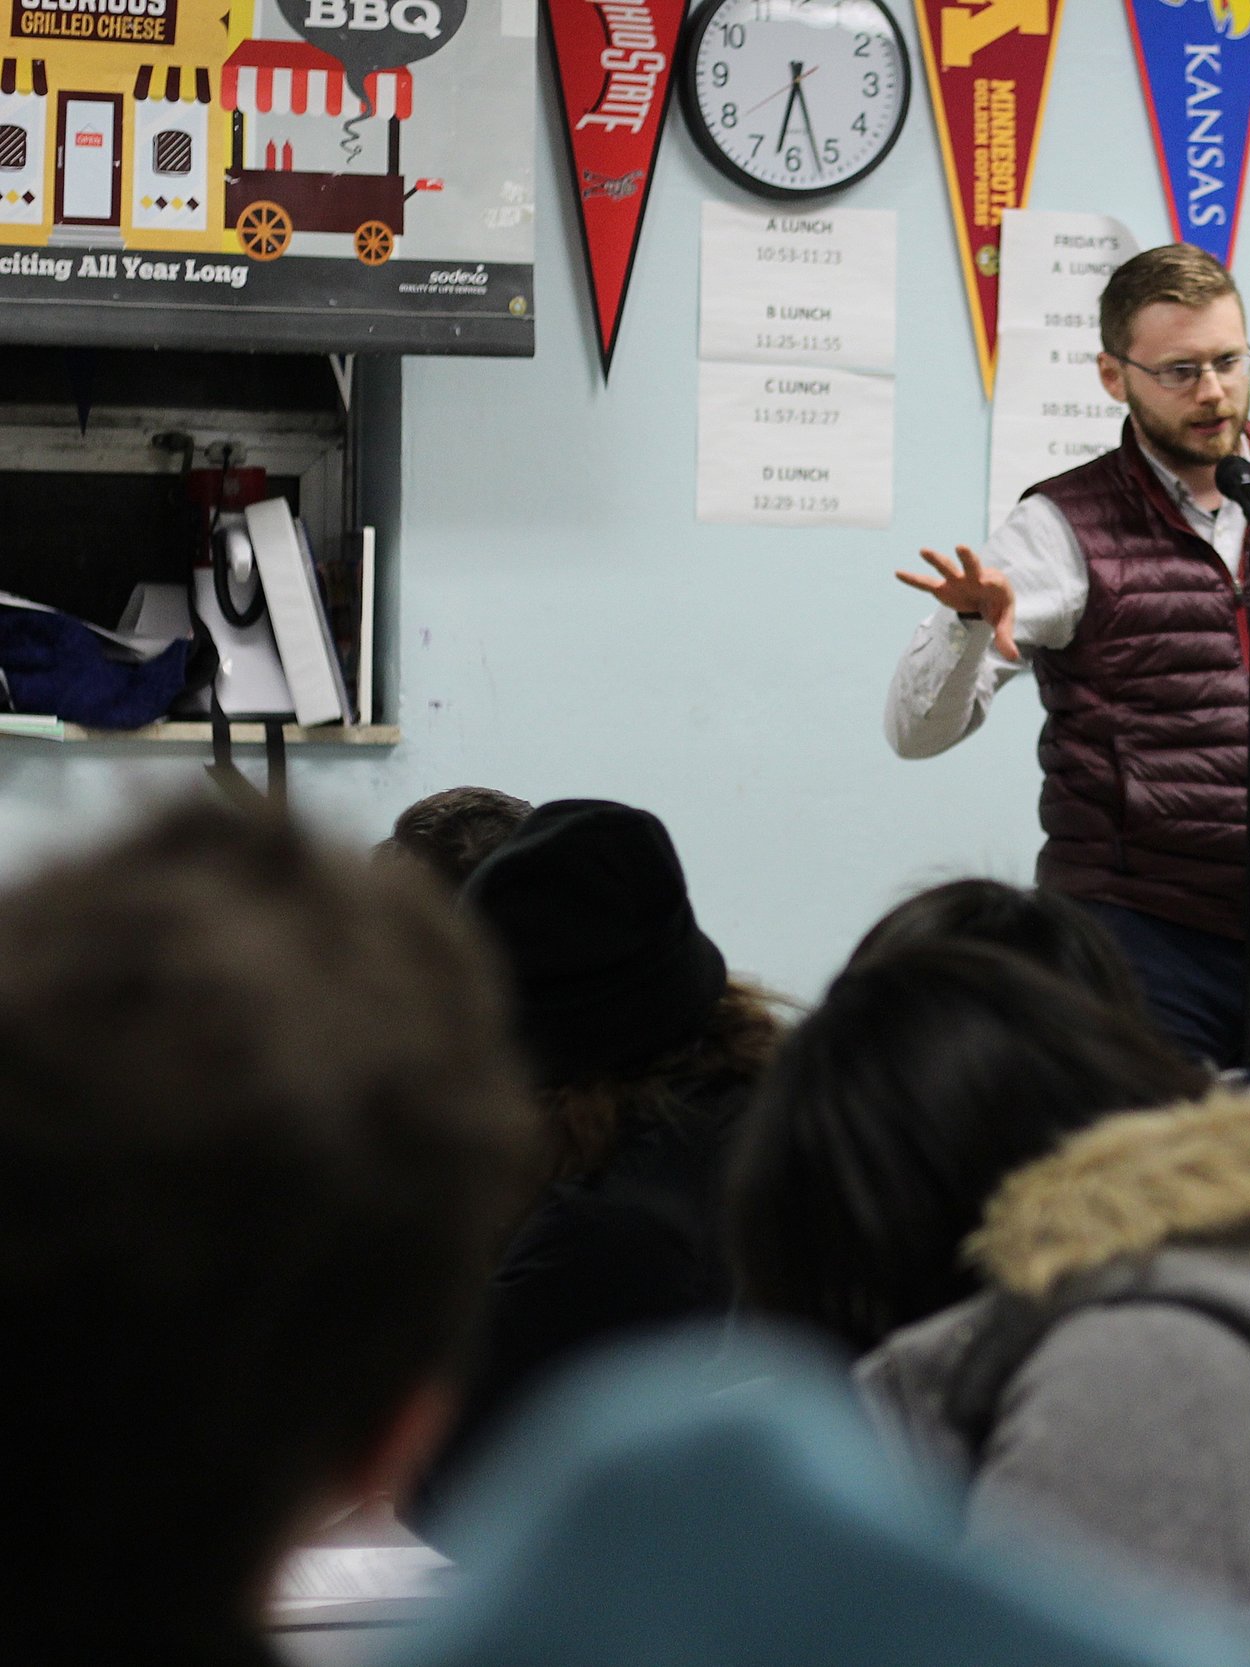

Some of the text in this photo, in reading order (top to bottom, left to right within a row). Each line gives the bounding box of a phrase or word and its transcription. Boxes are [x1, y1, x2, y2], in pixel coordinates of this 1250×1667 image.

[21, 11, 166, 41] GRILLED CHEESE
[304, 0, 441, 40] BBQ
[721, 24, 745, 49] 10
[854, 32, 871, 57] 2
[712, 61, 729, 87] 9
[862, 72, 879, 98] 3
[576, 47, 666, 133] STATE
[721, 102, 737, 128] 8
[851, 113, 867, 136] 4
[749, 134, 765, 158] 7
[1184, 43, 1226, 226] KANSAS
[785, 147, 801, 172] 6
[824, 139, 839, 163] 5
[766, 219, 833, 234] A LUNCH
[1055, 235, 1120, 251] FRIDAY'S
[78, 254, 117, 278] All
[122, 256, 181, 281] Year
[185, 259, 249, 289] Long
[767, 306, 831, 320] B LUNCH
[765, 380, 830, 395] C LUNCH
[763, 468, 829, 482] D LUNCH
